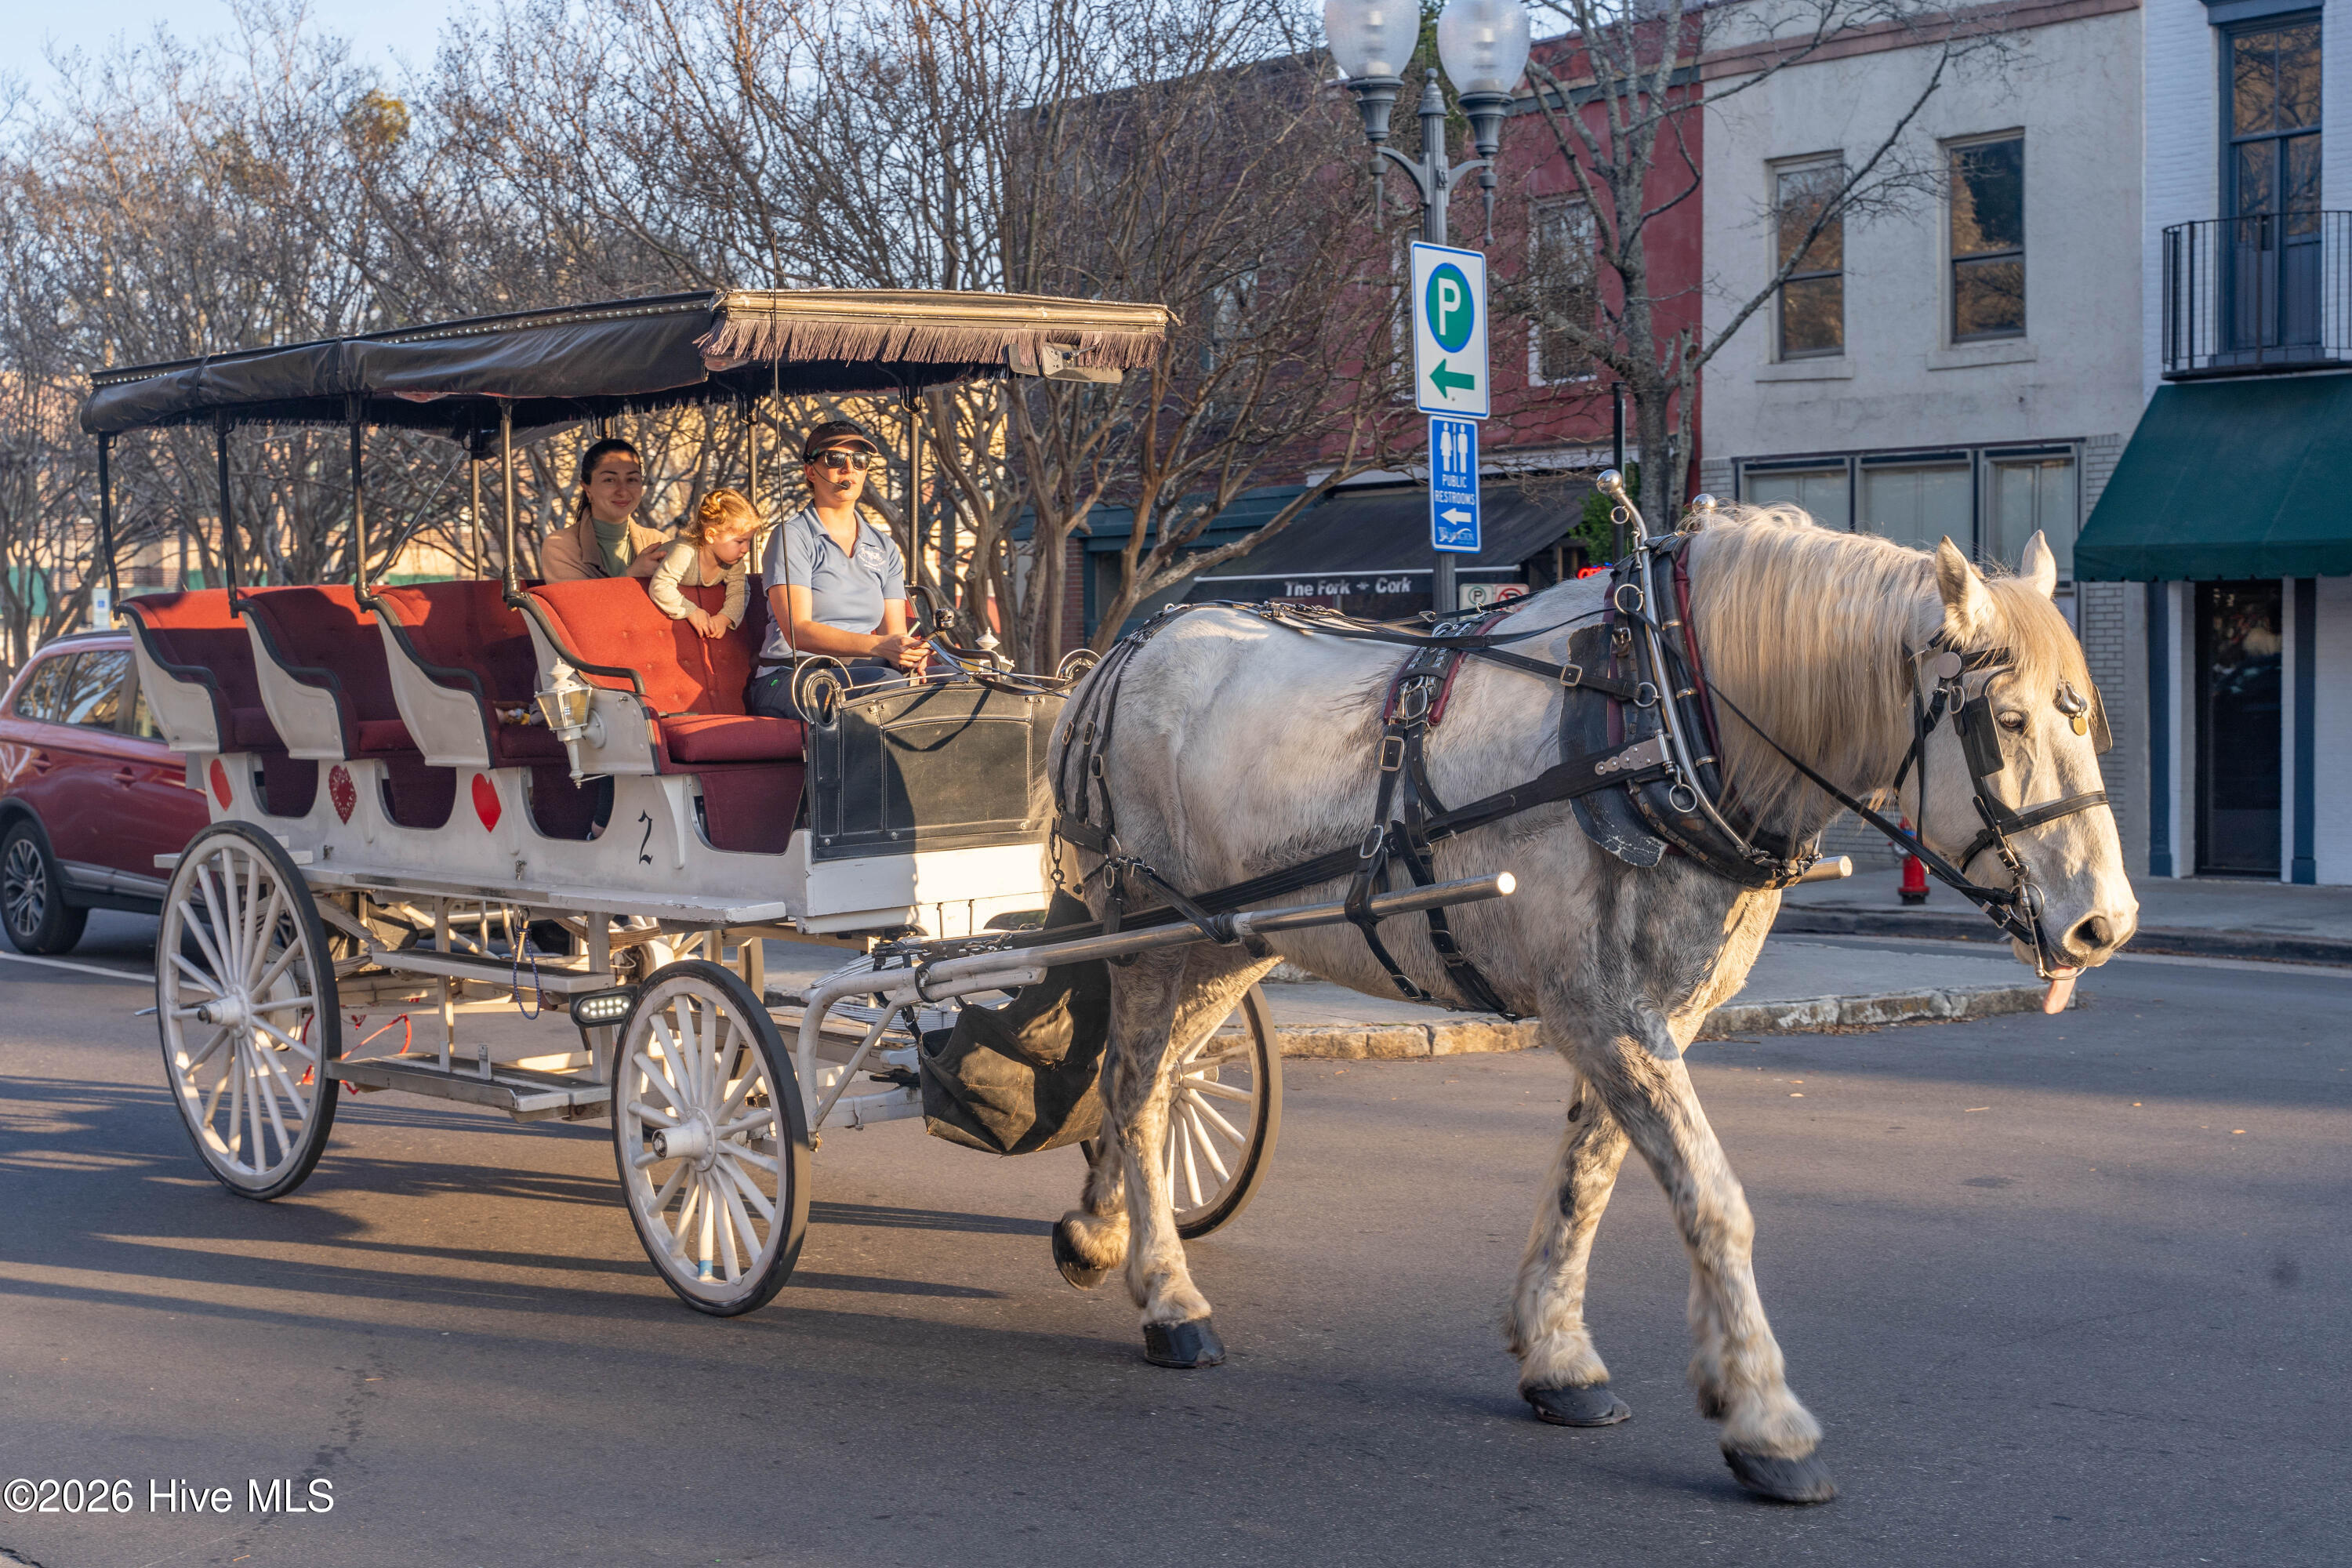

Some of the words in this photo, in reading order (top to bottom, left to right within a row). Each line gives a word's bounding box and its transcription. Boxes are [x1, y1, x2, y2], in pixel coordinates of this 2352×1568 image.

[1438, 278, 1461, 336] P
[1442, 474, 1468, 488] PUBLIC
[1434, 490, 1475, 506] RESTROOMS
[1284, 580, 1314, 597] The
[1317, 579, 1351, 596] Fork
[1375, 576, 1412, 593] Cork
[1473, 590, 1483, 601] P
[637, 809, 653, 866] 2
